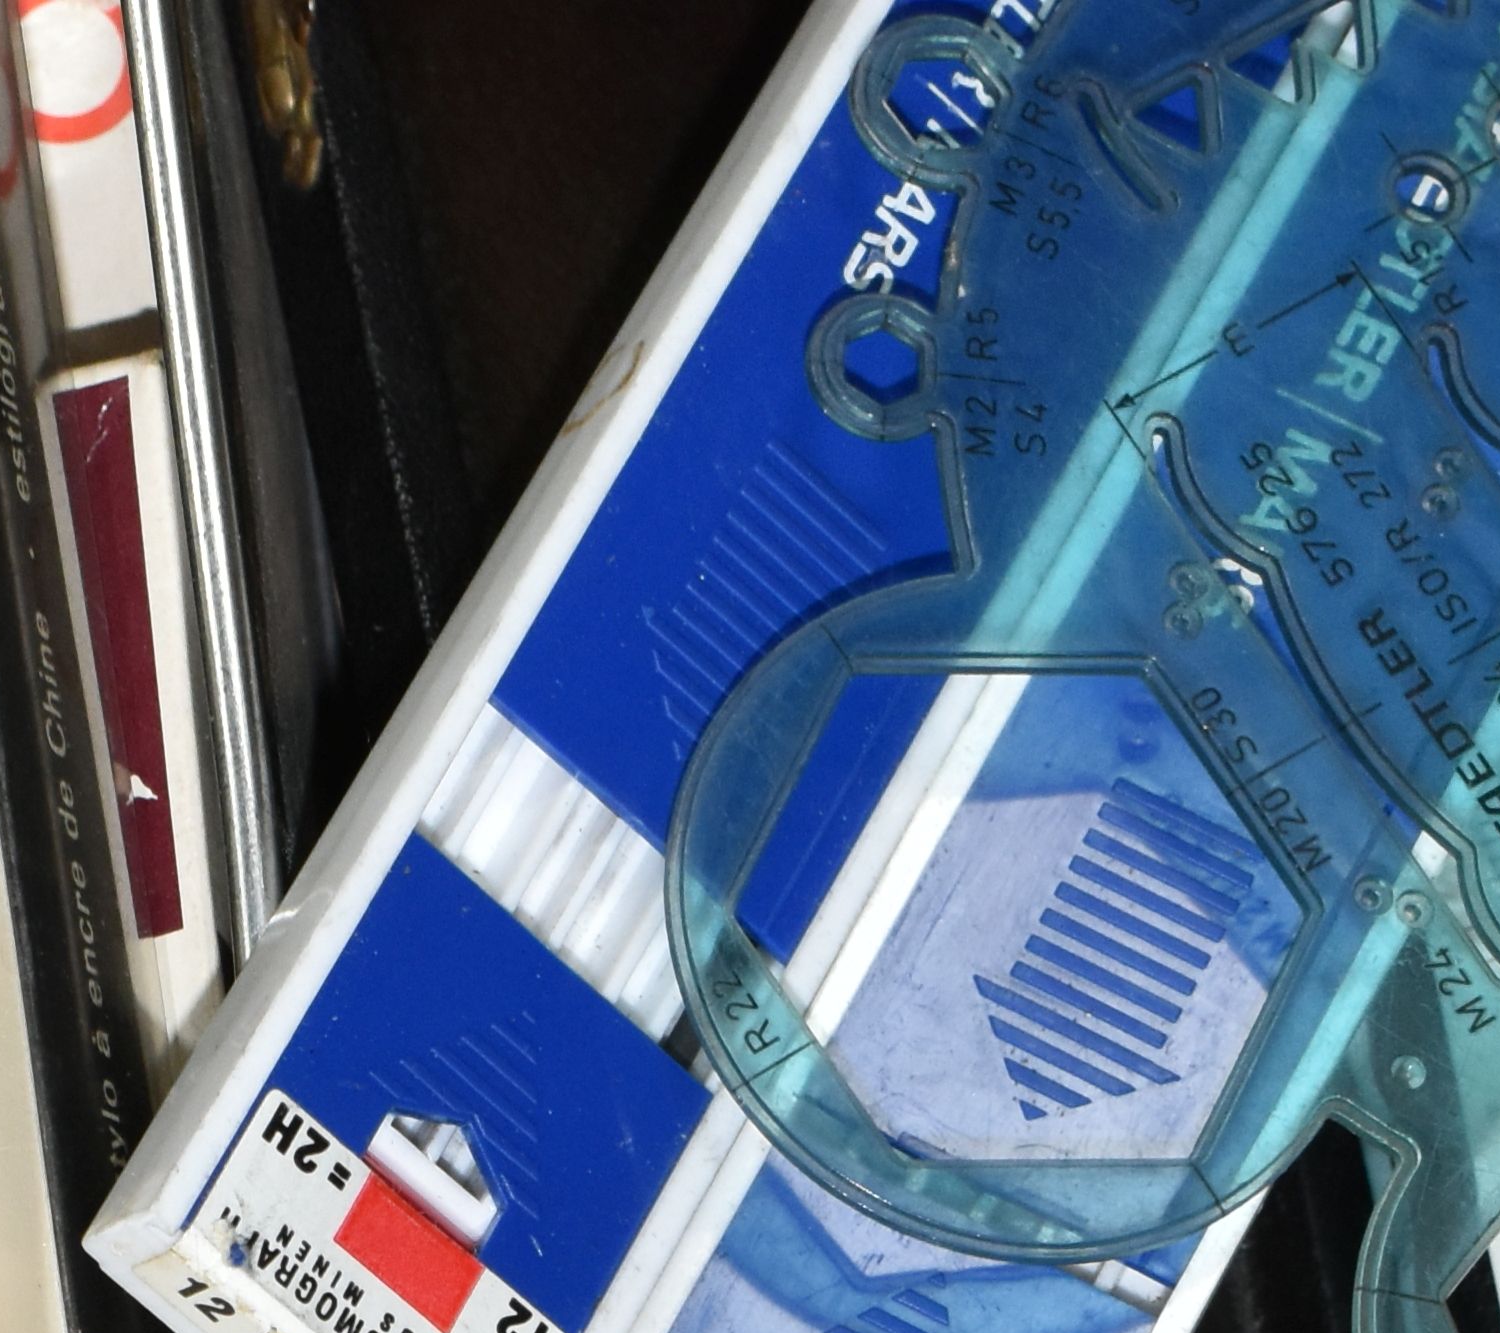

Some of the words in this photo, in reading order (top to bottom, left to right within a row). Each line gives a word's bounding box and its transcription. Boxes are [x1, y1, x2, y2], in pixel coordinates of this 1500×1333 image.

[1330, 440, 1392, 509] 272
[1285, 506, 1354, 587] 576
[44, 608, 71, 759] Chine
[61, 790, 81, 844] de
[77, 869, 103, 1007] encre
[262, 1222, 364, 1308] MINEN
